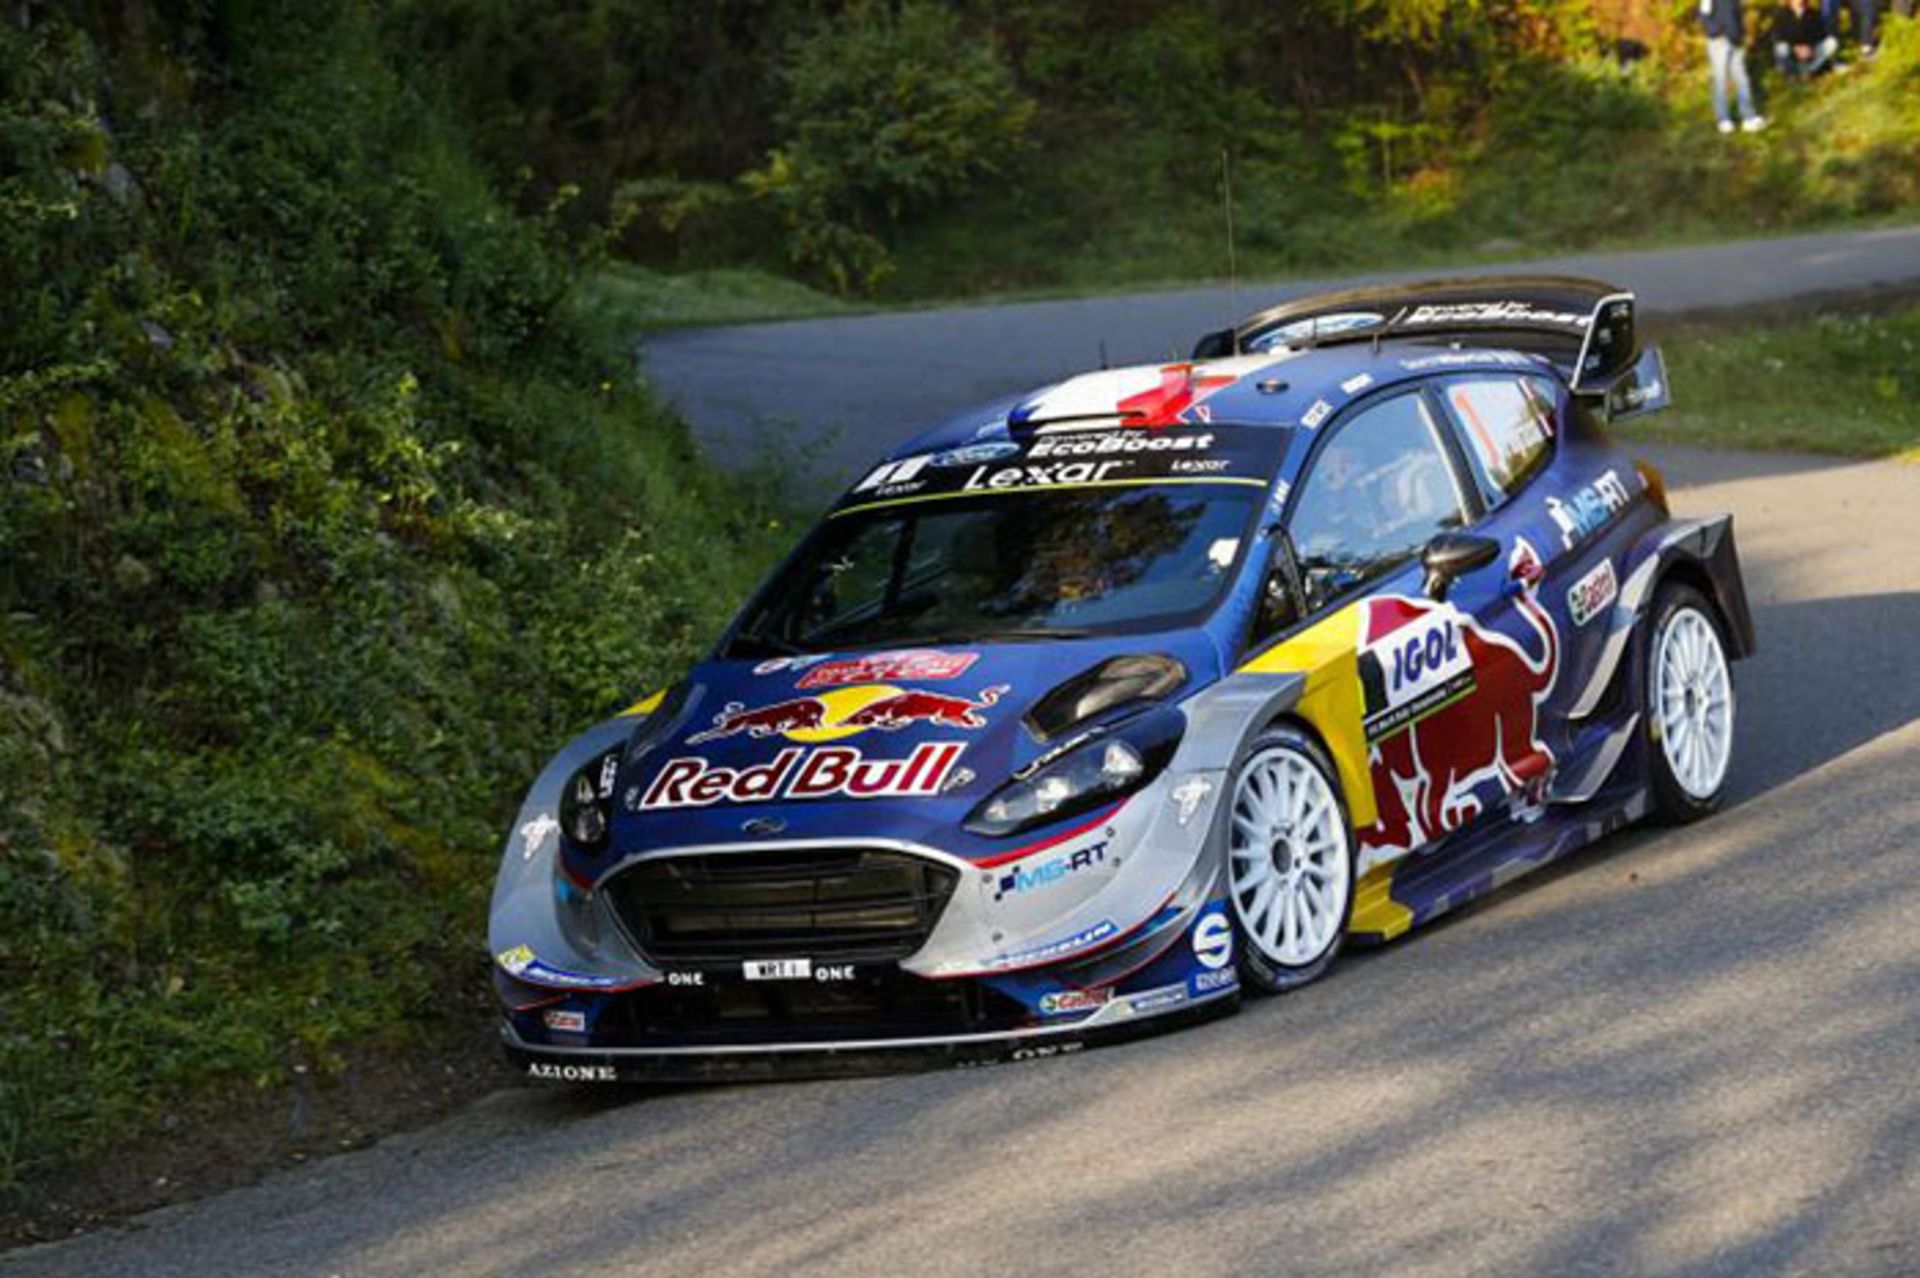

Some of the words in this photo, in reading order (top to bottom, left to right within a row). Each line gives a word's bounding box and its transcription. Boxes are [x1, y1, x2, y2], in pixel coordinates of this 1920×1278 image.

[1027, 434, 1215, 459] EcoBoost
[962, 458, 1123, 491] Lexar
[1171, 459, 1231, 473] Lexar
[1393, 620, 1457, 691] IGOL
[638, 744, 798, 811] Red
[788, 741, 969, 799] Bull
[1016, 841, 1108, 893] MS-RT
[667, 972, 704, 986] ONE
[815, 964, 856, 983] ONE
[527, 1063, 617, 1081] AZIONE
